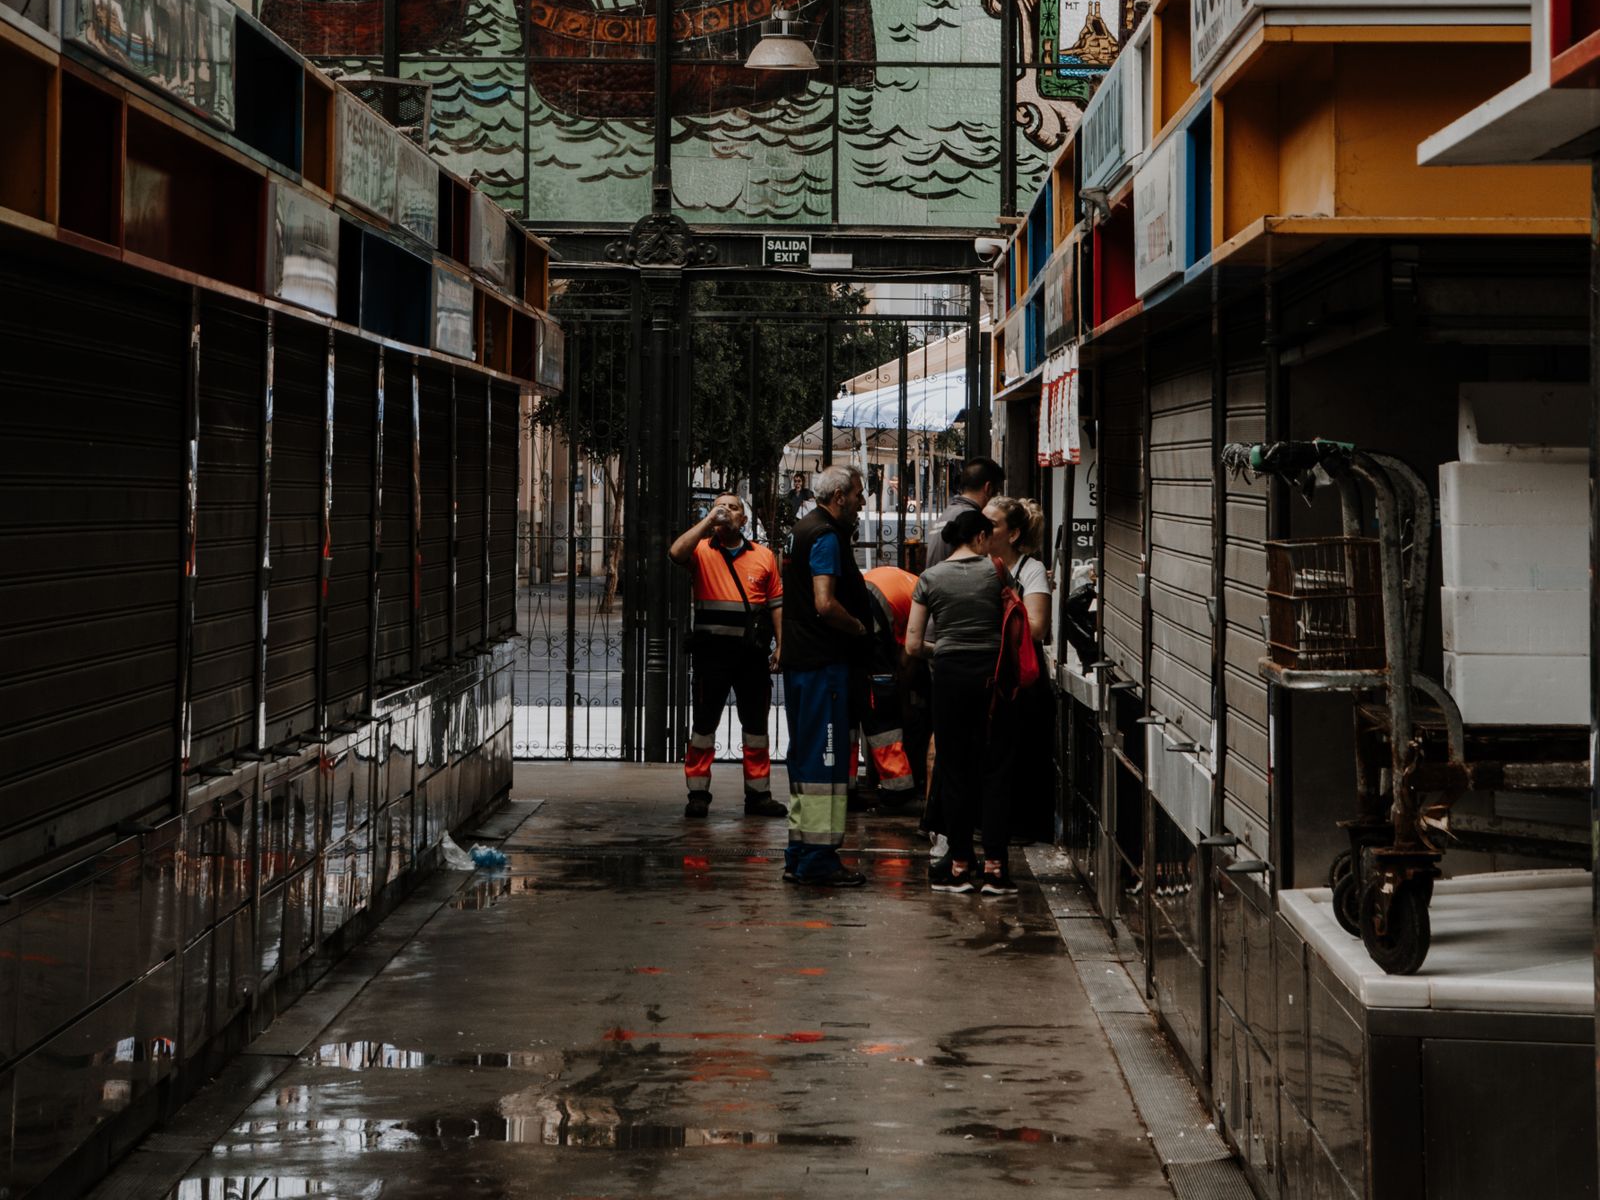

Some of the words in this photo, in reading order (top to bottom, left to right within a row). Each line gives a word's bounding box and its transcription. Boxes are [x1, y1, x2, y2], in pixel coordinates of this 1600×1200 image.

[767, 241, 807, 251] SALIDA
[774, 252, 800, 262] EXIT
[1072, 522, 1090, 532] Del
